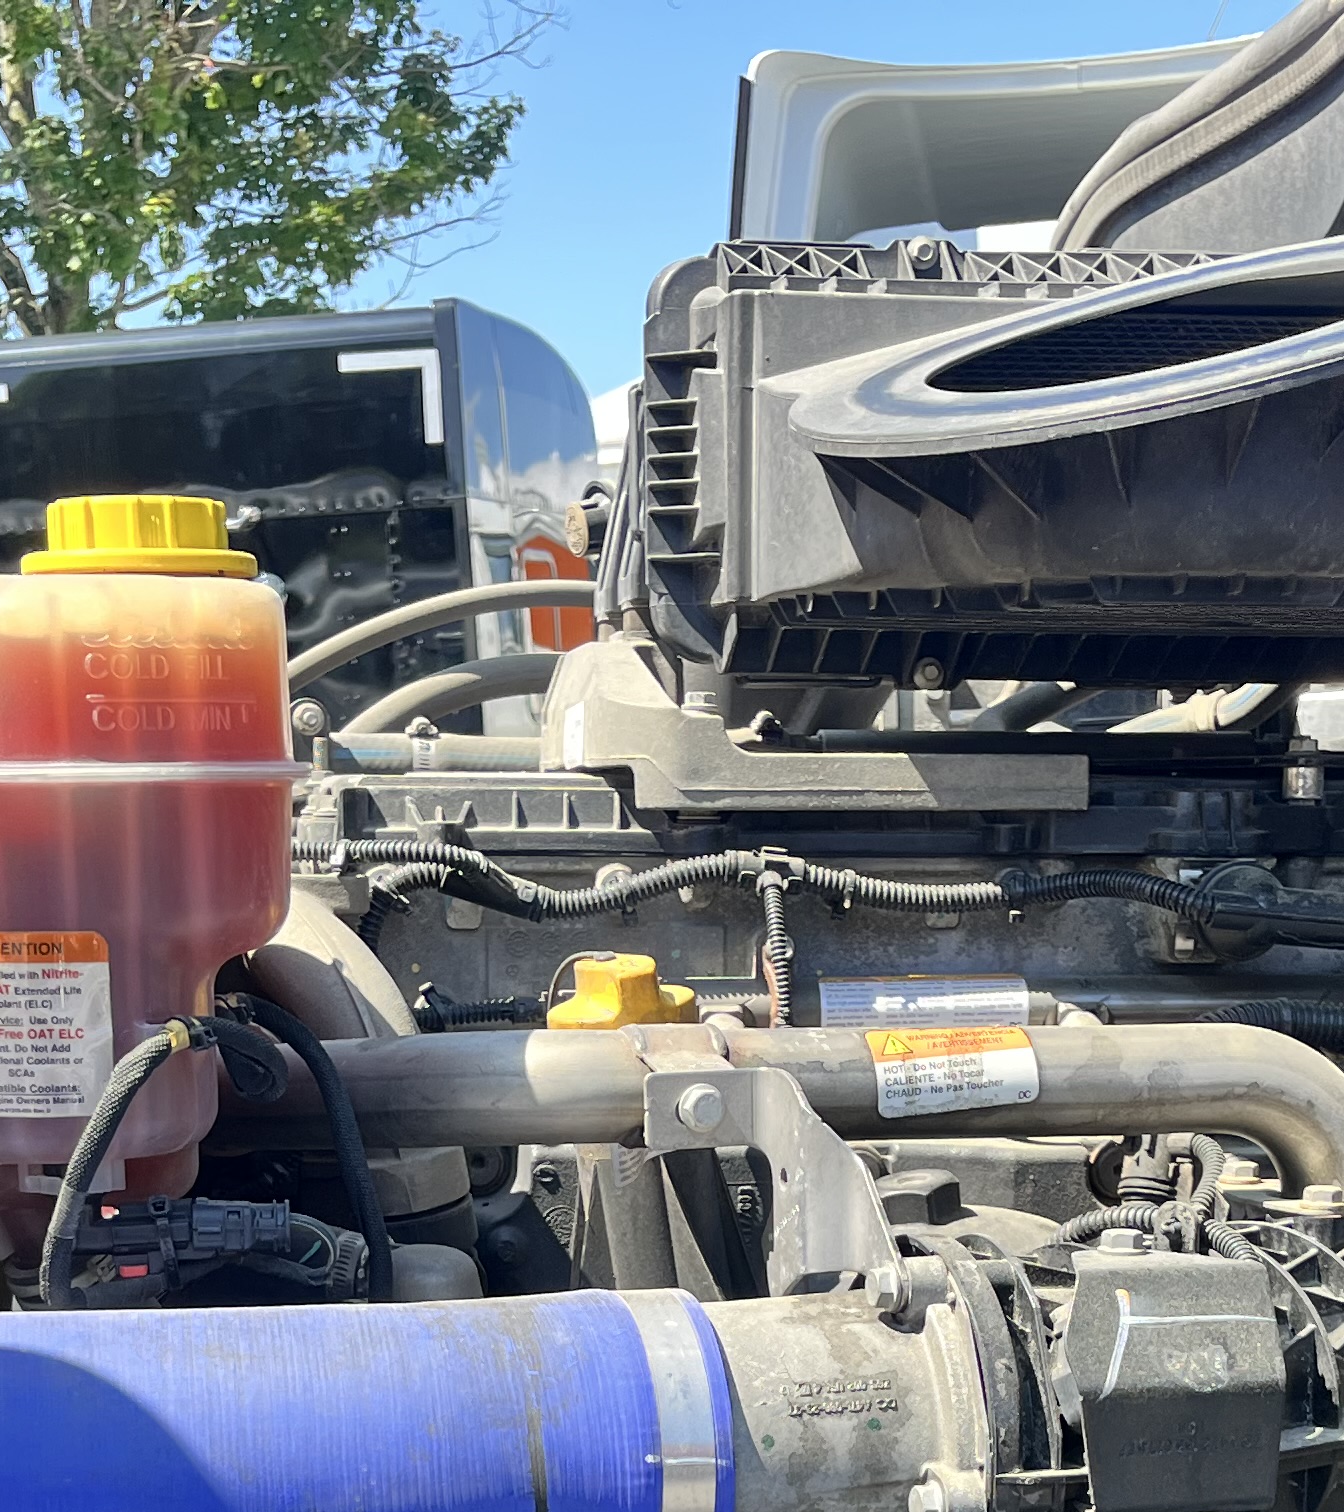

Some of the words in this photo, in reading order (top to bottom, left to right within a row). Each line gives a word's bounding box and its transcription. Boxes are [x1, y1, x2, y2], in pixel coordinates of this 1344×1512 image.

[84, 653, 170, 680] COLD
[185, 654, 231, 680] FILL
[92, 704, 176, 731] COLD
[194, 704, 232, 731] MIN
[18, 971, 39, 979] with
[42, 968, 84, 979] Nitrite-
[15, 986, 60, 996] Extended
[64, 986, 82, 995] Life
[24, 1000, 52, 1010] (ELC)
[30, 1016, 48, 1024] Use
[51, 1015, 73, 1026] Only
[27, 1028, 54, 1039] OAT
[59, 1028, 84, 1039] ELC
[906, 1033, 946, 1042] WARNING
[932, 1037, 1003, 1049] AVERTISSEMENT
[14, 1044, 28, 1053] Do
[31, 1044, 48, 1053] Not
[51, 1044, 71, 1053] Add
[27, 1056, 70, 1065] Coolants
[884, 1065, 903, 1075] HOT
[913, 1062, 926, 1071] Do
[930, 1061, 946, 1070] Not
[948, 1057, 976, 1068] Touch
[8, 1069, 35, 1078] SCAs
[885, 1073, 935, 1087] CALIENTE
[944, 1071, 956, 1080] No
[960, 1069, 985, 1079] Tocar
[29, 1083, 81, 1093] Coolants:
[886, 1086, 922, 1099] CHAUD
[931, 1086, 943, 1094] Ne
[947, 1084, 963, 1093] Pas
[967, 1079, 1004, 1090] Toucher
[1018, 1090, 1032, 1099] DC
[16, 1096, 50, 1104] Owners
[53, 1096, 84, 1104] Manual
